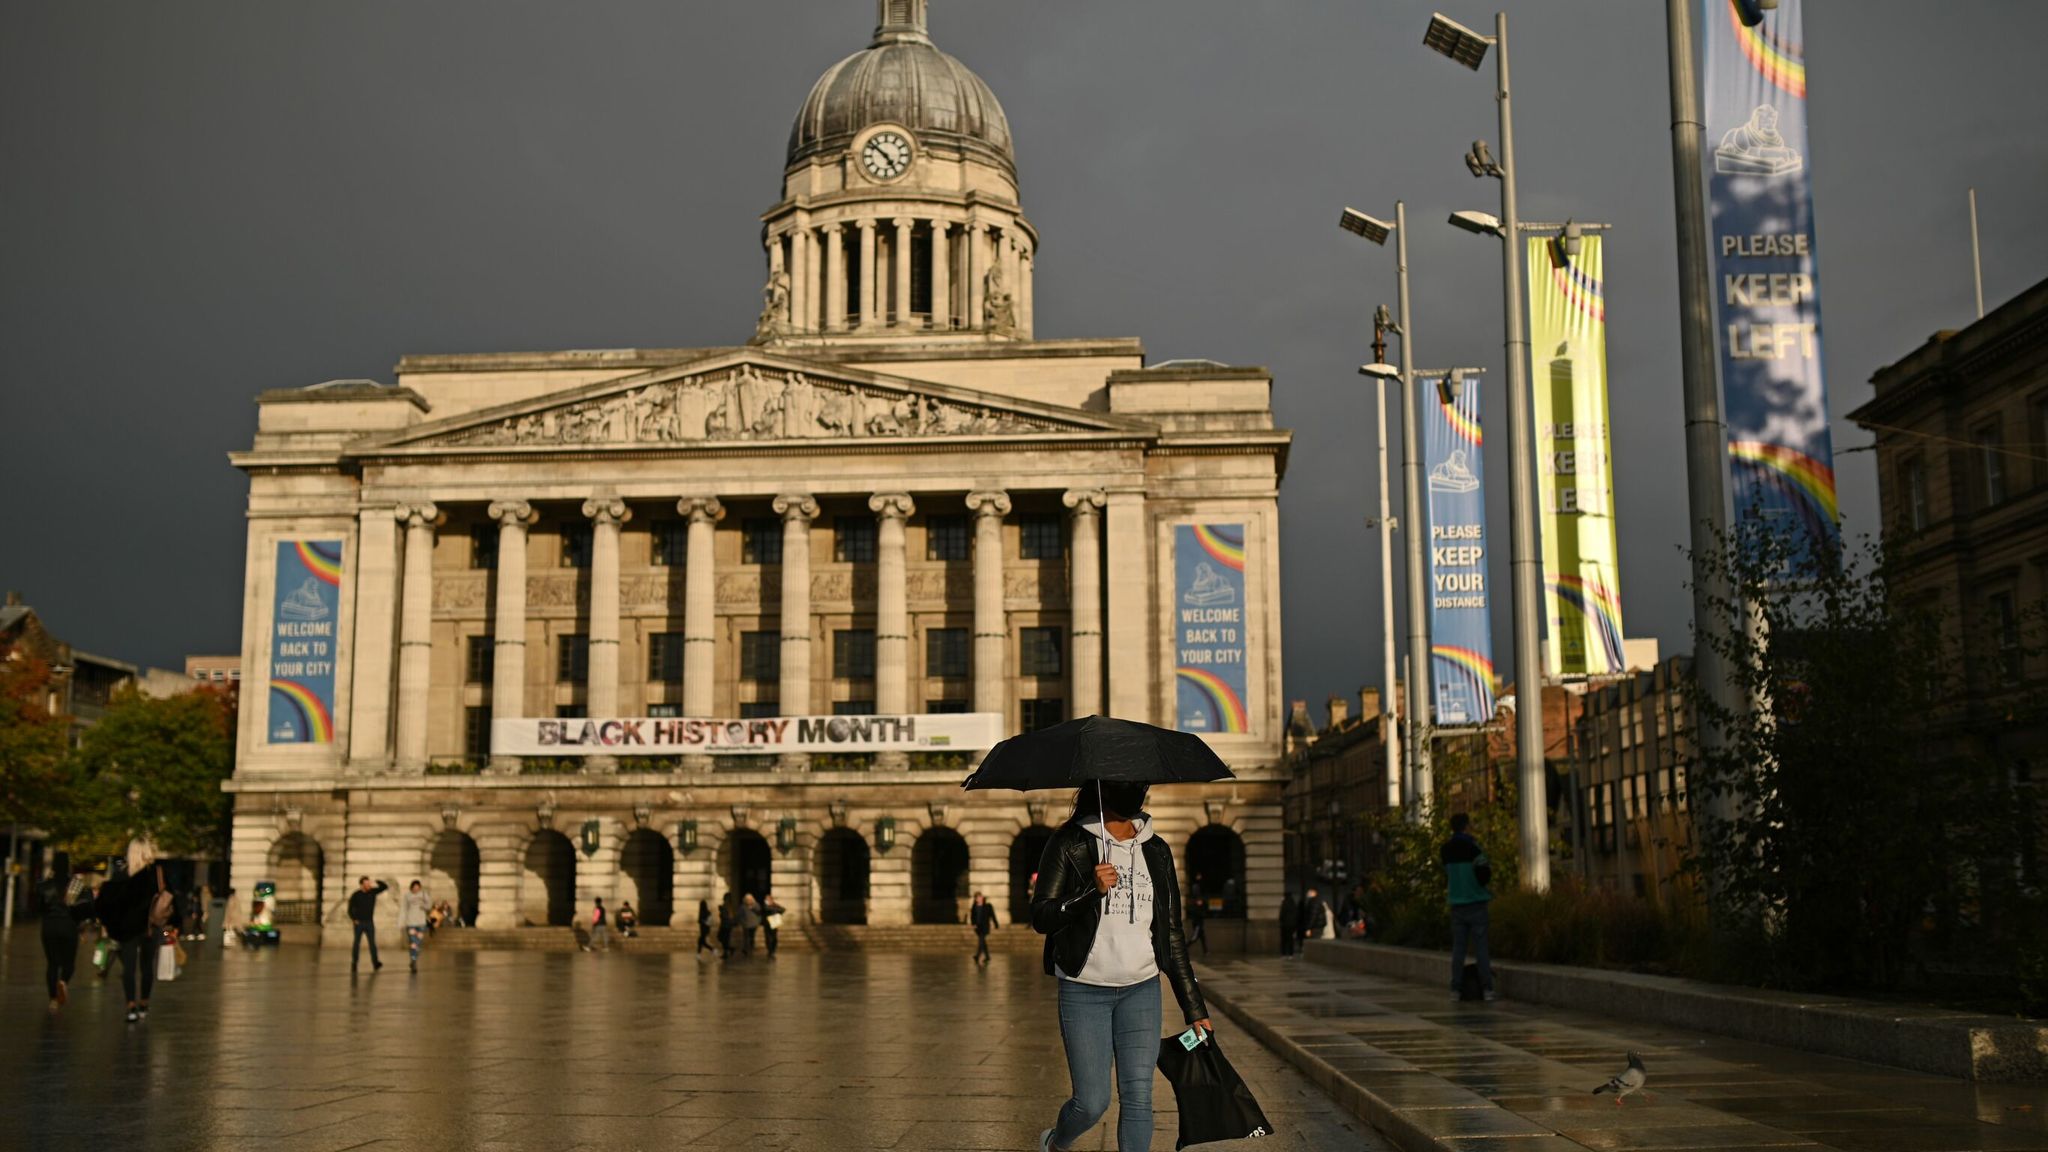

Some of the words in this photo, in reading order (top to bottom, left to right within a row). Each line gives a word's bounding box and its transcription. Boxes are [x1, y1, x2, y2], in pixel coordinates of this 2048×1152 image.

[1722, 233, 1808, 256] PLEASE
[1725, 273, 1812, 307] KEEP
[1728, 323, 1816, 359] LEFT
[1433, 525, 1482, 539] PLEASE
[1433, 546, 1484, 567] KEEP
[1435, 573, 1484, 592] YOUR
[1435, 596, 1486, 608] DISTANCE
[1182, 608, 1240, 623] WELCOME
[277, 621, 332, 637] WELCOME
[1186, 629, 1217, 643] BACK
[1221, 629, 1236, 643] TO
[280, 642, 309, 656] BACK
[312, 641, 327, 656] TO
[1181, 649, 1212, 664] YOUR
[1215, 649, 1242, 664] CITY
[274, 662, 303, 676] YOUR
[306, 662, 331, 676] CITY
[537, 721, 646, 746] BLACK
[653, 719, 790, 745] HISTORY
[797, 717, 916, 744] MONTH
